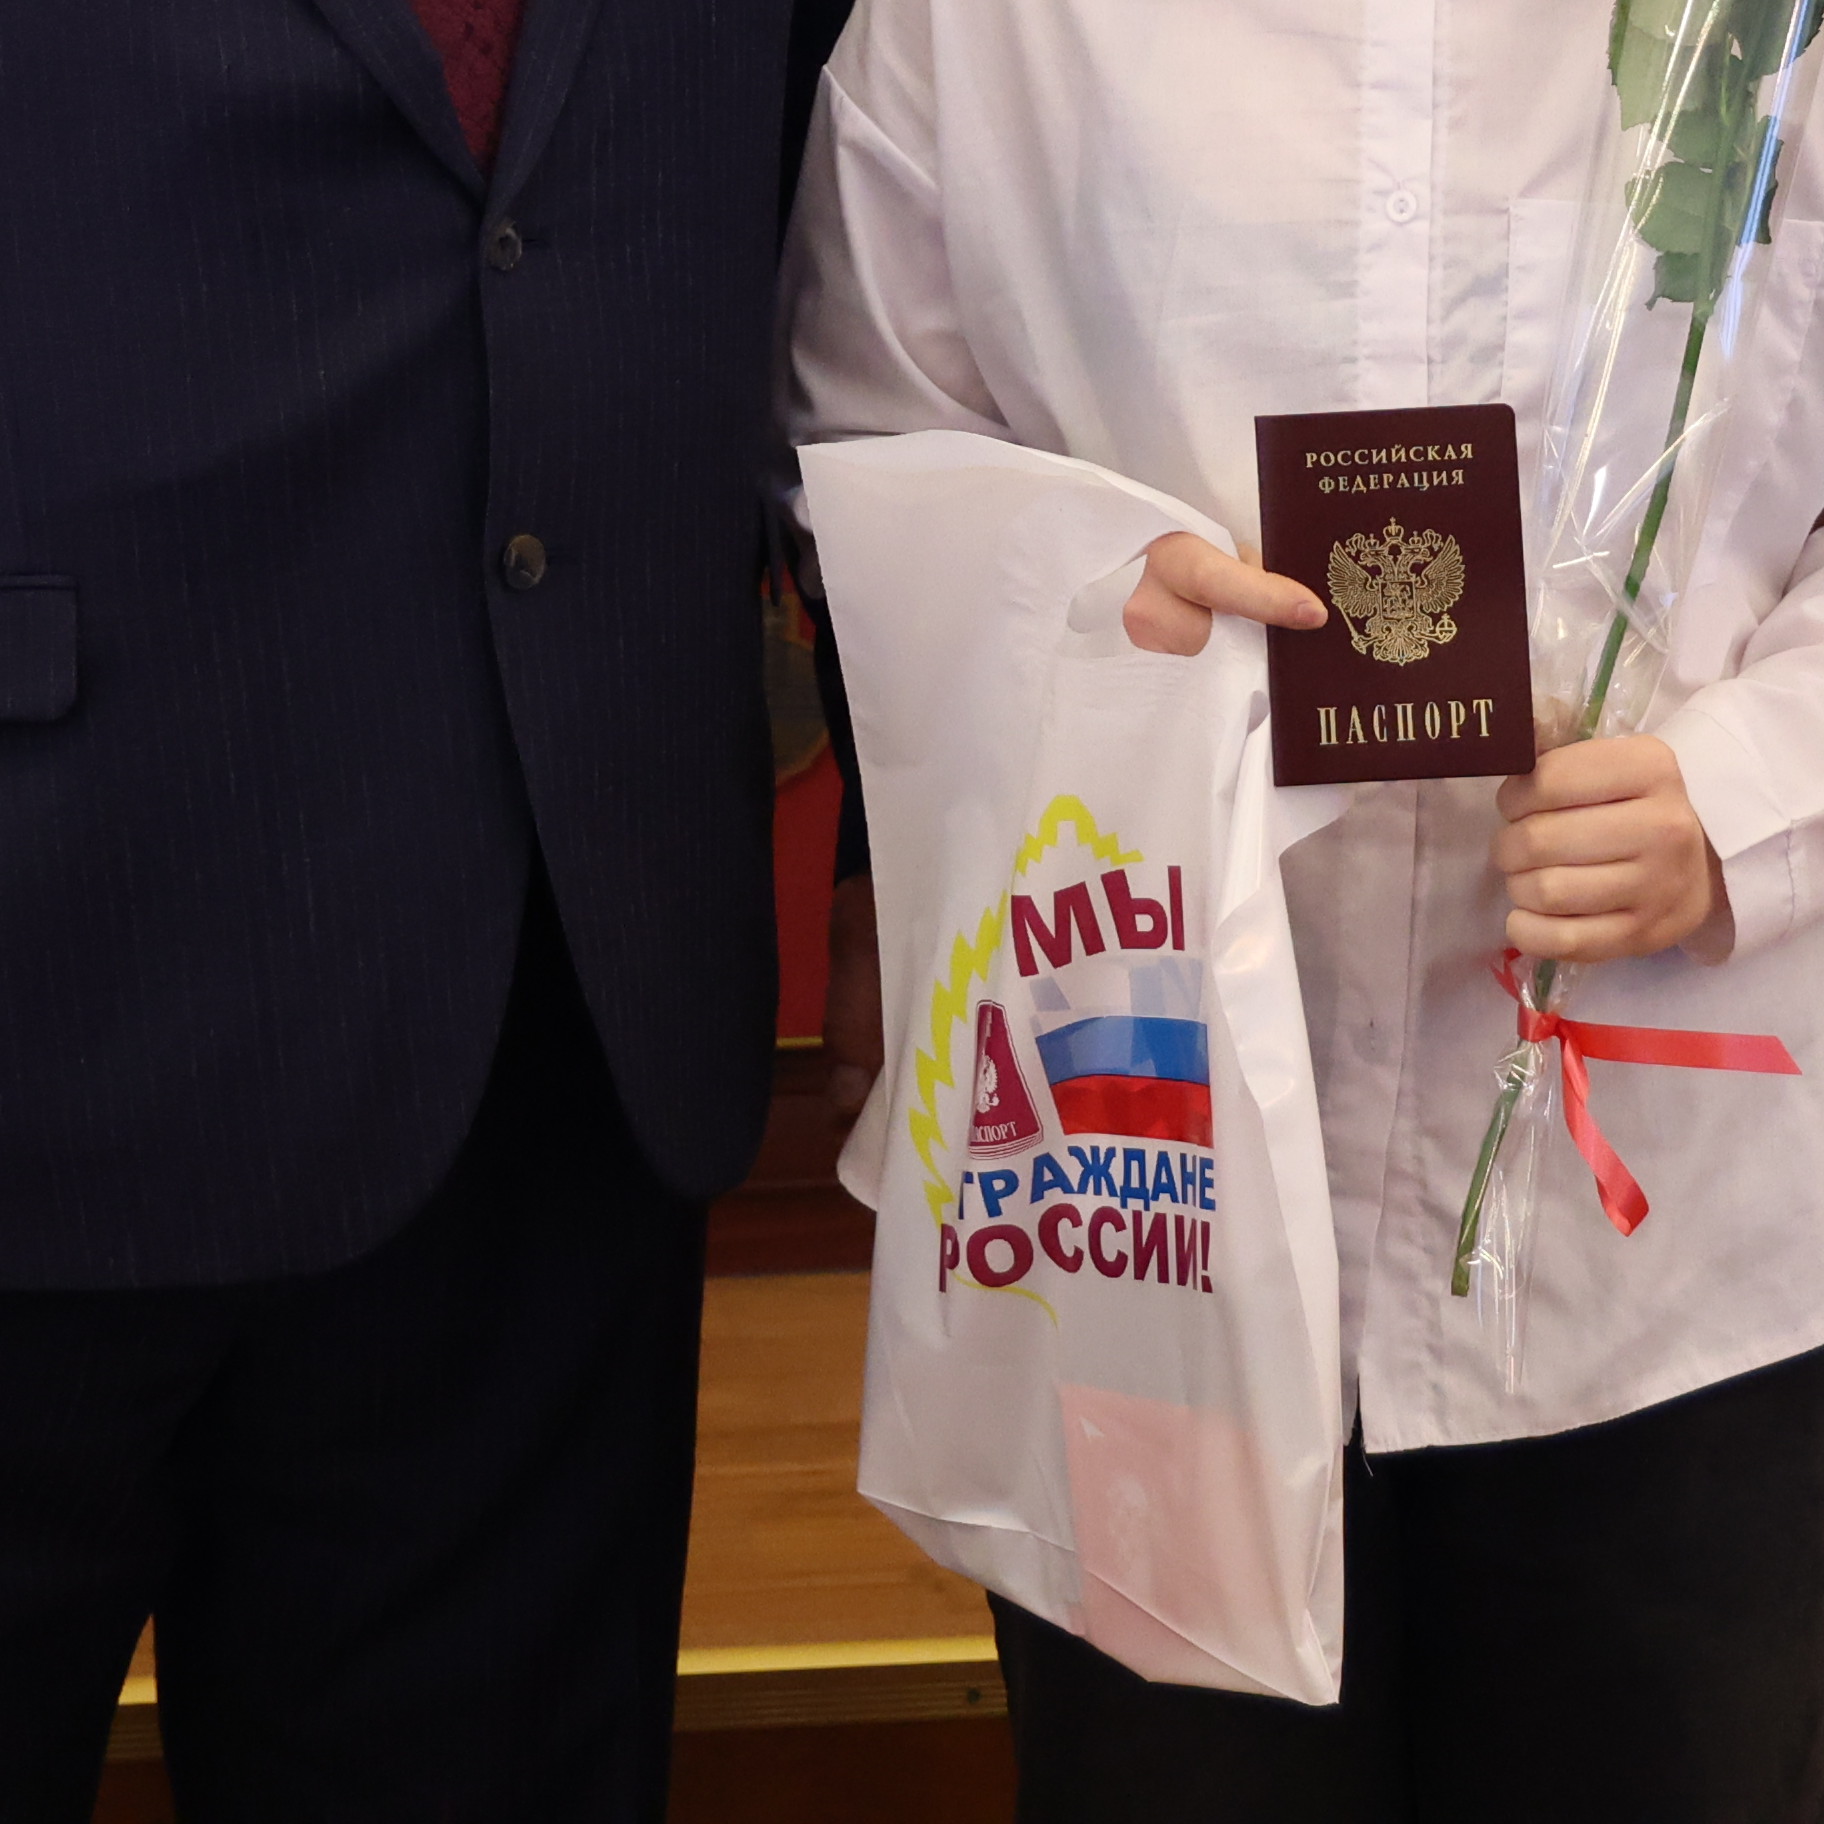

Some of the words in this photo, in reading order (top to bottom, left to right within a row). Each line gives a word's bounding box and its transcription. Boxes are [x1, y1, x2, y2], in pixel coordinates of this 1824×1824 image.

[1305, 443, 1474, 468] РОССИЙСКАЯ
[1318, 468, 1466, 494] ФЕДЕРАЦИЯ
[1316, 698, 1494, 746] ПАСПОРТ
[1010, 865, 1185, 977] МЫ
[958, 1145, 1216, 1220] ГРАЖДАНЕ
[938, 1203, 1214, 1294] РОССИИ!
